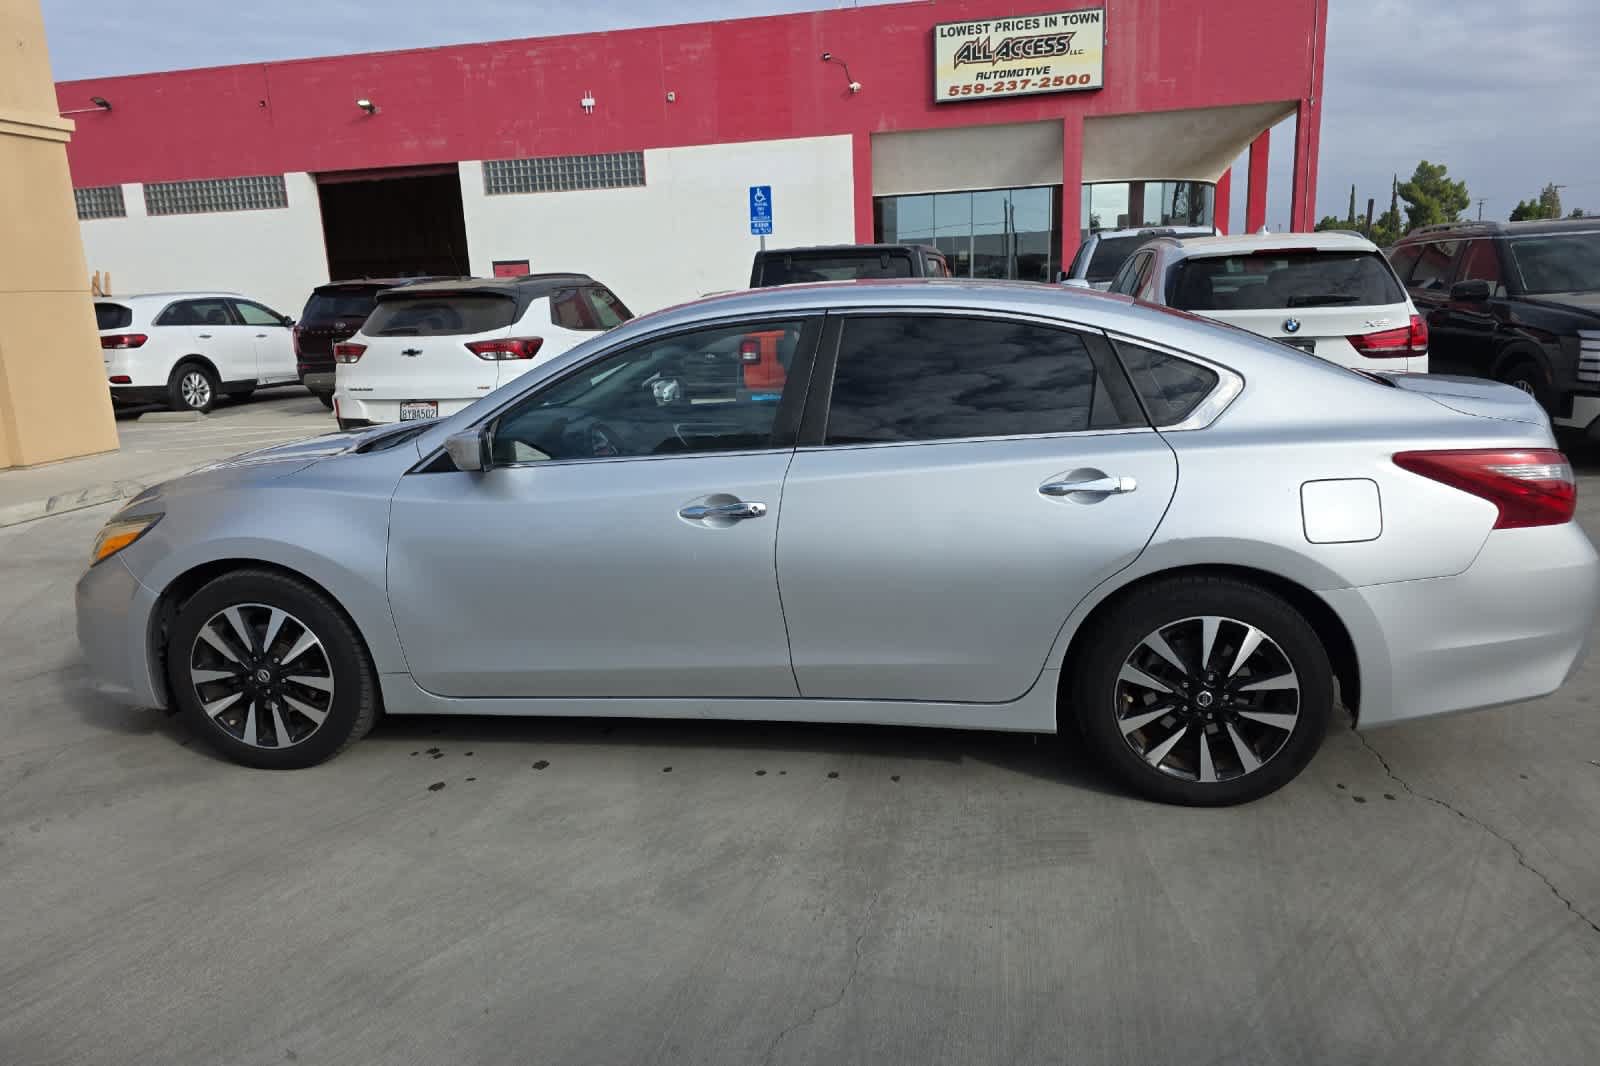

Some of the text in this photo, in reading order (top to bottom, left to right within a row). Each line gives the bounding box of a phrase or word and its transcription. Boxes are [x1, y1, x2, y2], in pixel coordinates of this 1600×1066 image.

[940, 12, 1100, 38] LOWEST PRICES IN TOWN
[954, 36, 993, 69] ALL
[992, 32, 1075, 66] ACCESS
[948, 74, 1091, 96] 559-237-2500
[976, 66, 1051, 81] AUTOMOTIVE
